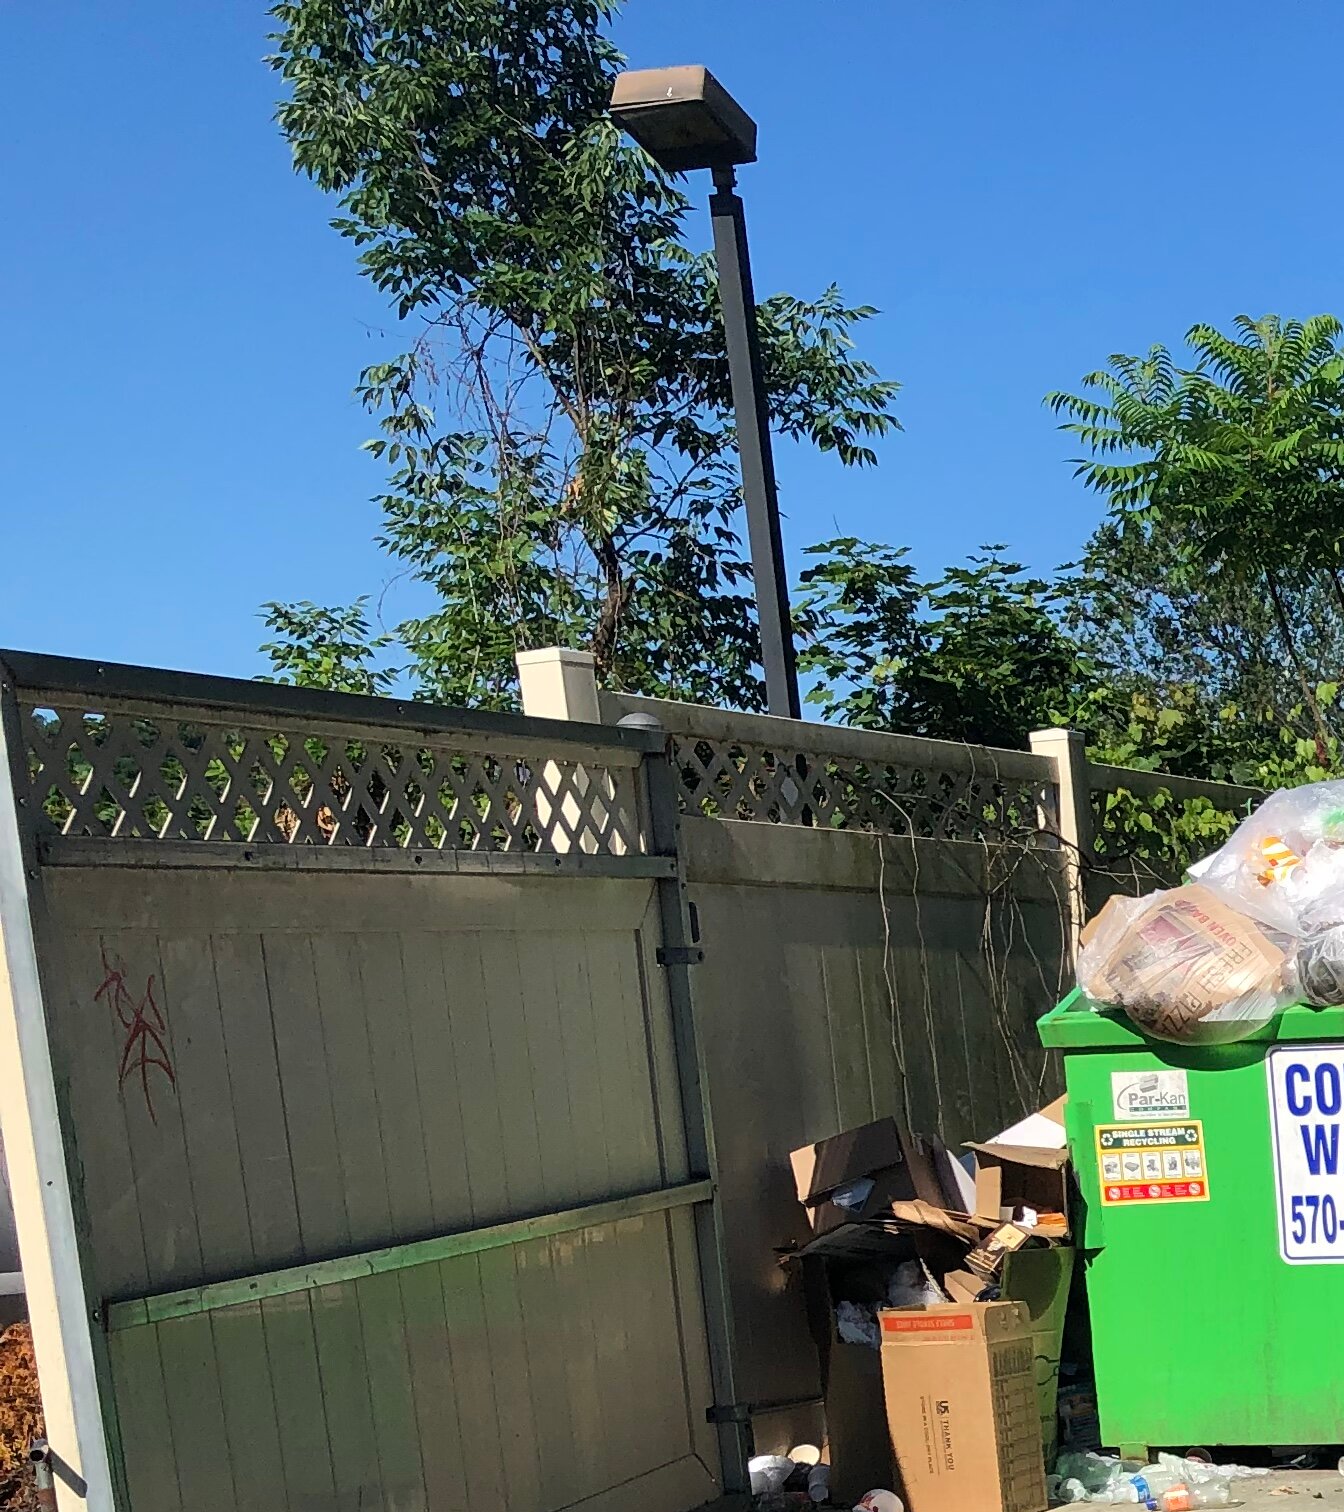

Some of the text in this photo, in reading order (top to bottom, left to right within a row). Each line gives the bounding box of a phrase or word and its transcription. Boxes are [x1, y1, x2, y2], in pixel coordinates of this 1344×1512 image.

[1207, 920, 1237, 946] OVEN
[1197, 942, 1253, 994] FRESH
[1128, 1091, 1186, 1106] Par-Kan
[1111, 1128, 1186, 1139] SINGLE STREAM
[1123, 1137, 1177, 1147] RECYCLING
[942, 1420, 952, 1449] THANK
[946, 1453, 955, 1471] YOU
